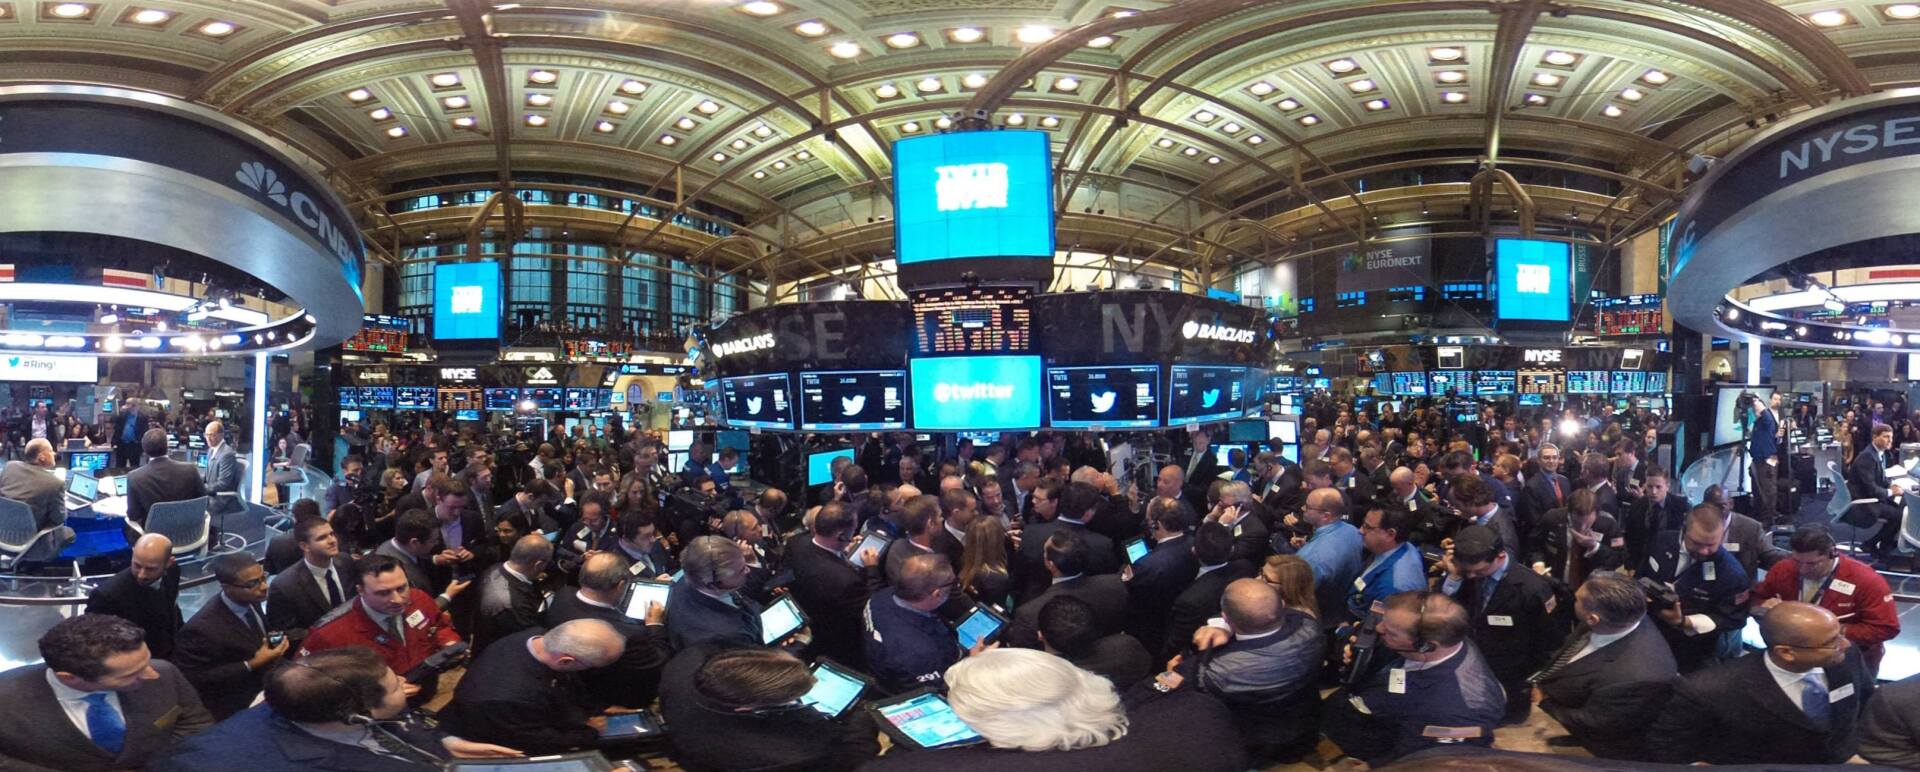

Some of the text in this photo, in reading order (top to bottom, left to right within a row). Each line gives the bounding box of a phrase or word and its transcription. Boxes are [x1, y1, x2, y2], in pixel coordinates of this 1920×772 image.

[1779, 116, 1920, 178] NYSE
[1366, 249, 1393, 260] NYSE
[1366, 256, 1422, 270] EURONEXT
[1197, 324, 1256, 343] BARCLAYS
[722, 332, 776, 355] BARCLAYS
[1524, 349, 1562, 361] NYSE
[441, 368, 477, 380] NYSE
[934, 382, 1014, 403] @twitter
[915, 670, 941, 682] 291
